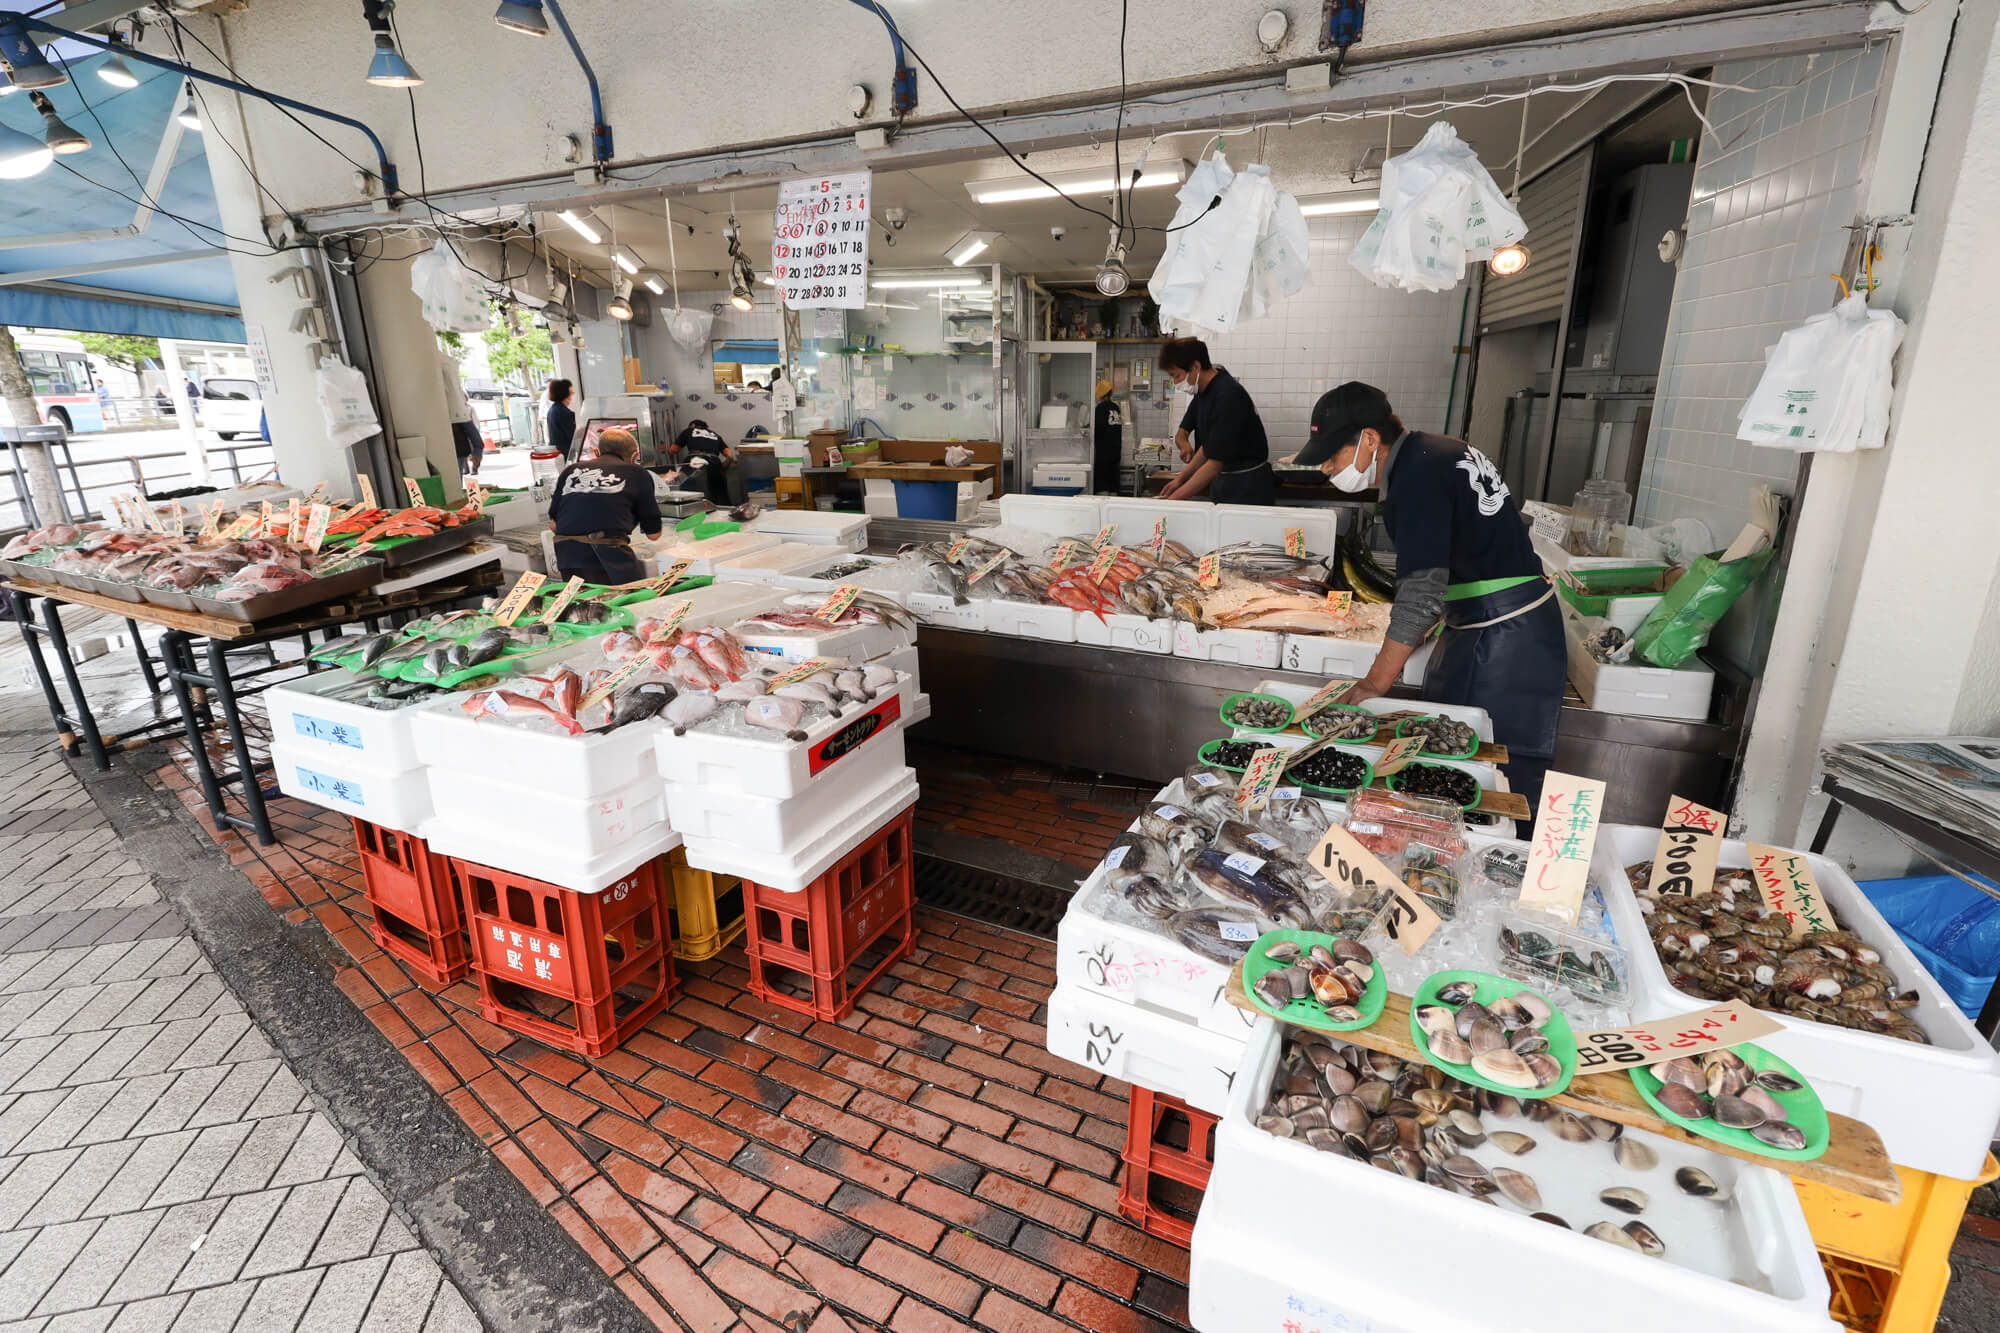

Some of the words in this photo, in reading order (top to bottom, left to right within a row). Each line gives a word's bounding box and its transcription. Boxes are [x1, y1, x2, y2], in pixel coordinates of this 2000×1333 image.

[820, 181, 830, 193] 5
[834, 202, 839, 212] 2
[846, 200, 852, 211] 3
[859, 199, 865, 211] 4
[782, 229, 788, 239] 5
[806, 225, 812, 236] 7
[818, 223, 824, 234] 8
[831, 222, 837, 233] 9
[841, 221, 850, 231] 10
[855, 221, 864, 231] 11
[776, 245, 788, 257] 12
[792, 247, 801, 258] 13
[805, 246, 812, 257] 14
[816, 245, 825, 256] 15
[828, 244, 837, 254] 16
[840, 242, 848, 253] 17
[853, 242, 862, 253] 18
[776, 265, 785, 278] 19
[789, 267, 801, 279] 20
[804, 268, 812, 279] 21
[813, 266, 824, 277] 22
[826, 265, 836, 276] 23
[839, 264, 848, 275] 24
[851, 264, 861, 275] 25
[788, 288, 798, 299] 27
[801, 289, 811, 299] 28
[812, 287, 821, 298] 29
[823, 287, 834, 297] 30
[838, 286, 847, 297] 31
[305, 720, 349, 744] 小柴
[308, 775, 350, 799] 小柴
[1536, 792, 1569, 891] とこぶし
[506, 949, 553, 981] 清酒
